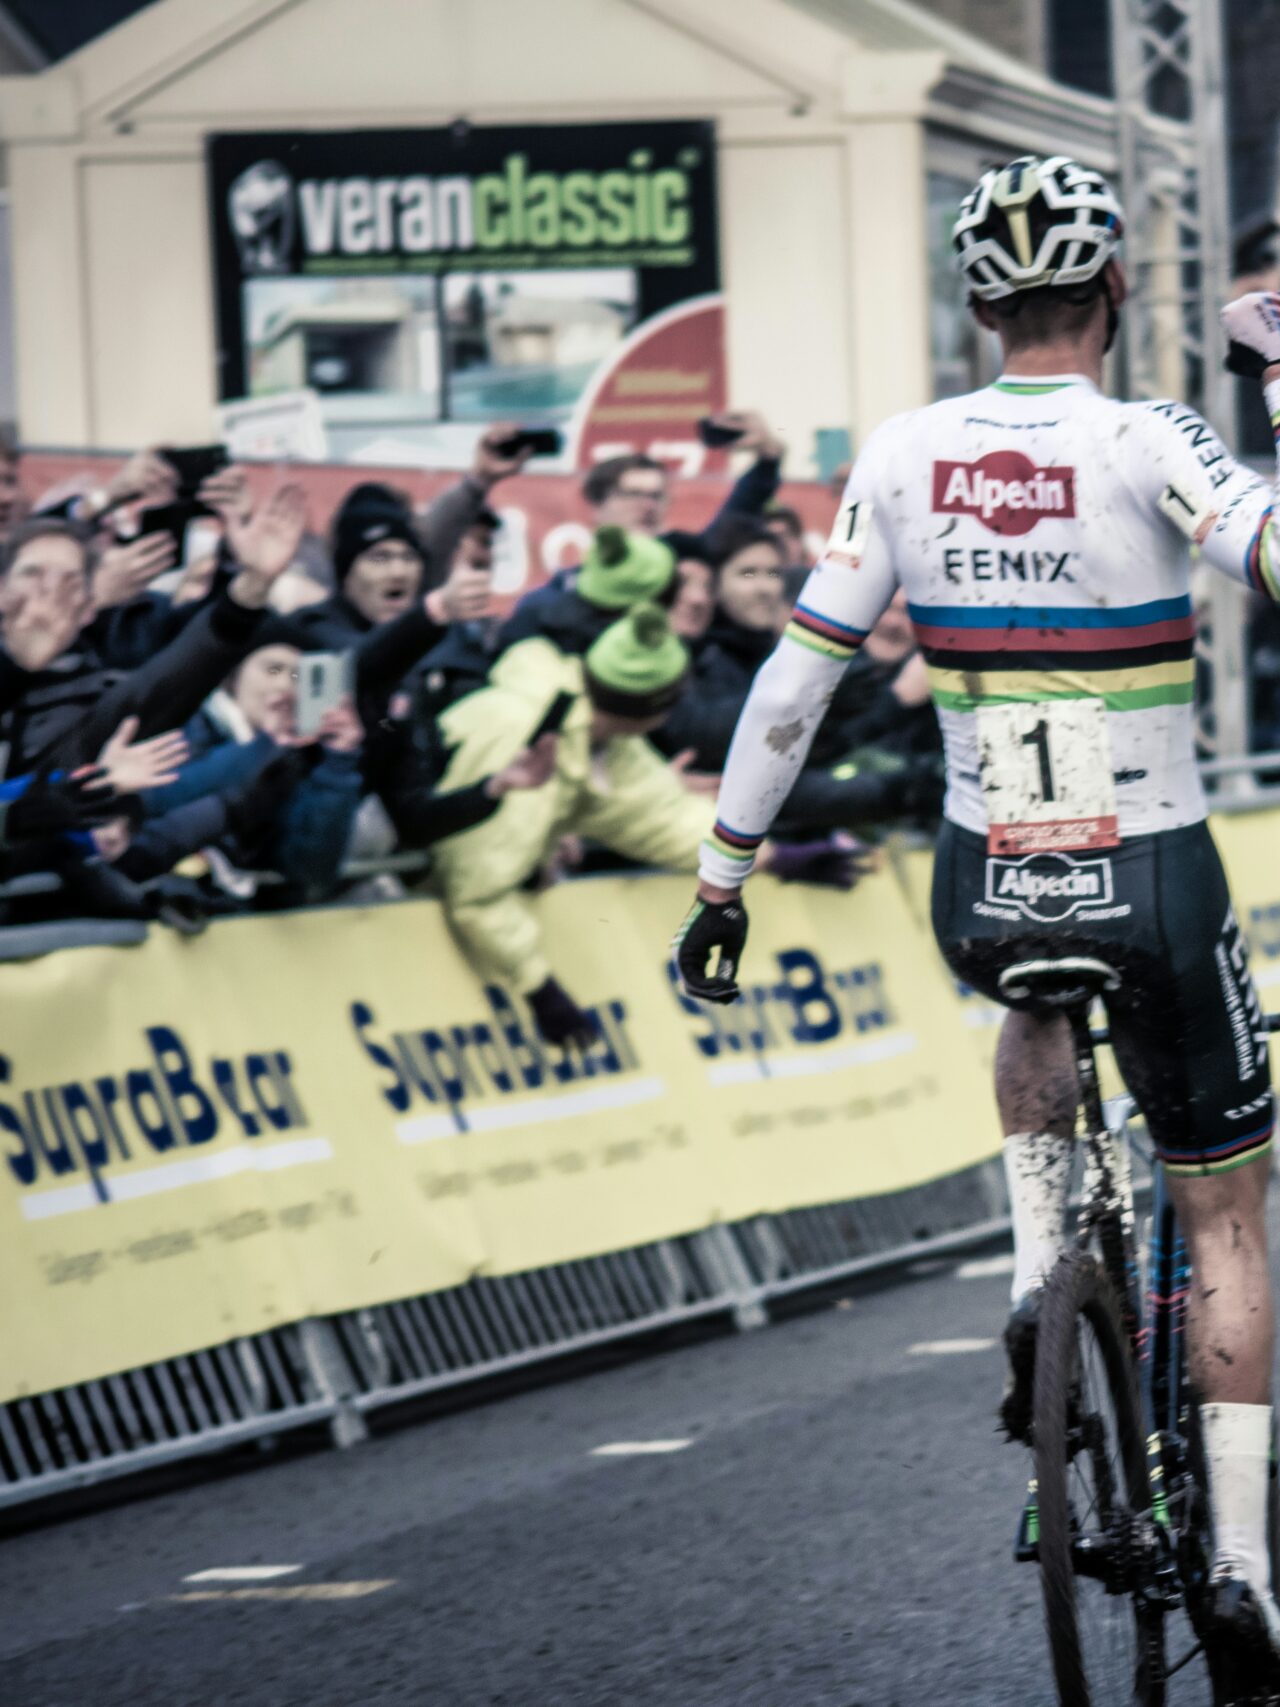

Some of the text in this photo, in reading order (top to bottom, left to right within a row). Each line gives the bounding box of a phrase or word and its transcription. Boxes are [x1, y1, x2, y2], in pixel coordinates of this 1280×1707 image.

[300, 150, 687, 256] veranclassic
[941, 466, 1067, 519] Alpecin
[1165, 483, 1197, 517] 1
[846, 500, 862, 542] 1
[944, 548, 1077, 584] FENIX
[1021, 718, 1056, 803] 1
[997, 867, 1101, 906] Alpecin
